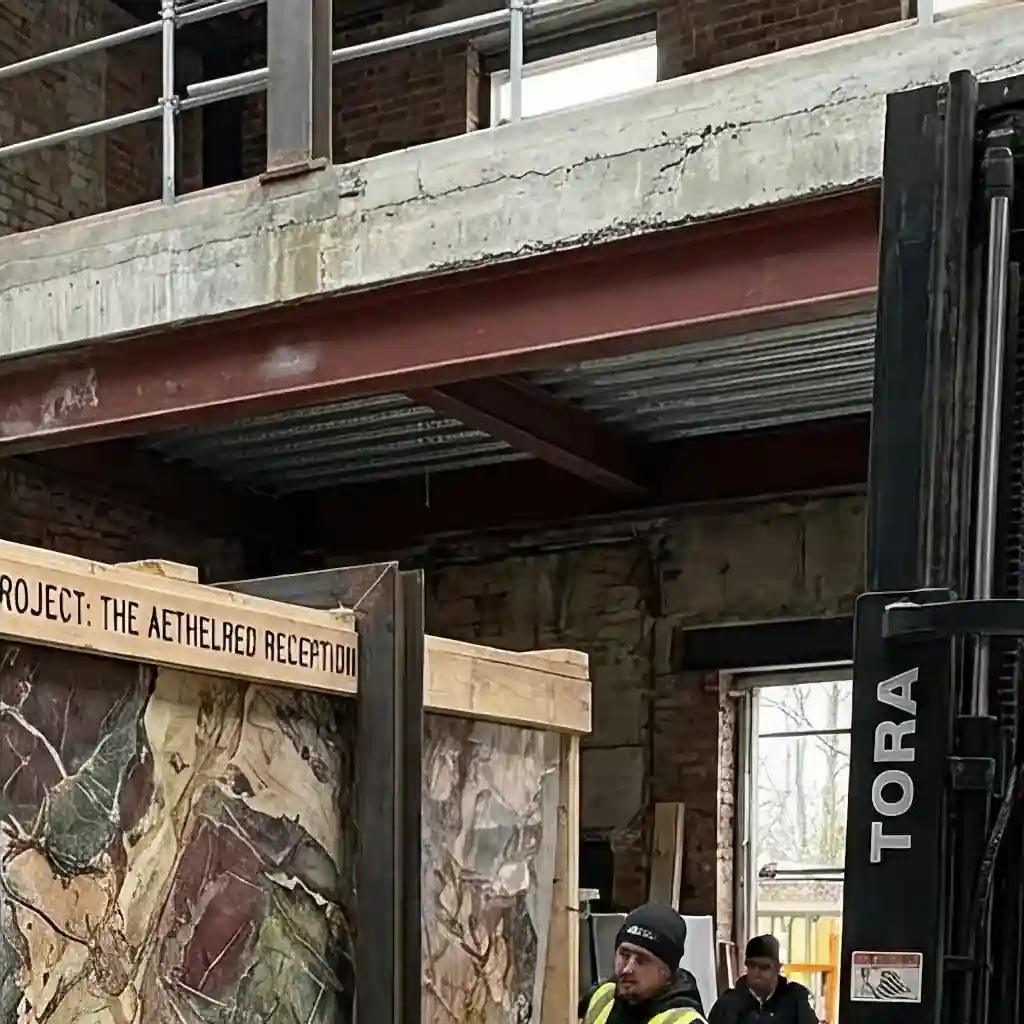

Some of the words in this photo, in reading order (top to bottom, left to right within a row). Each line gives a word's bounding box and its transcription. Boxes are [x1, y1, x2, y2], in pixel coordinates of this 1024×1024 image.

[0, 574, 91, 627] ROJECT:
[100, 595, 140, 637] THE
[147, 605, 257, 658] AETHELRED
[869, 666, 919, 863] TORA
